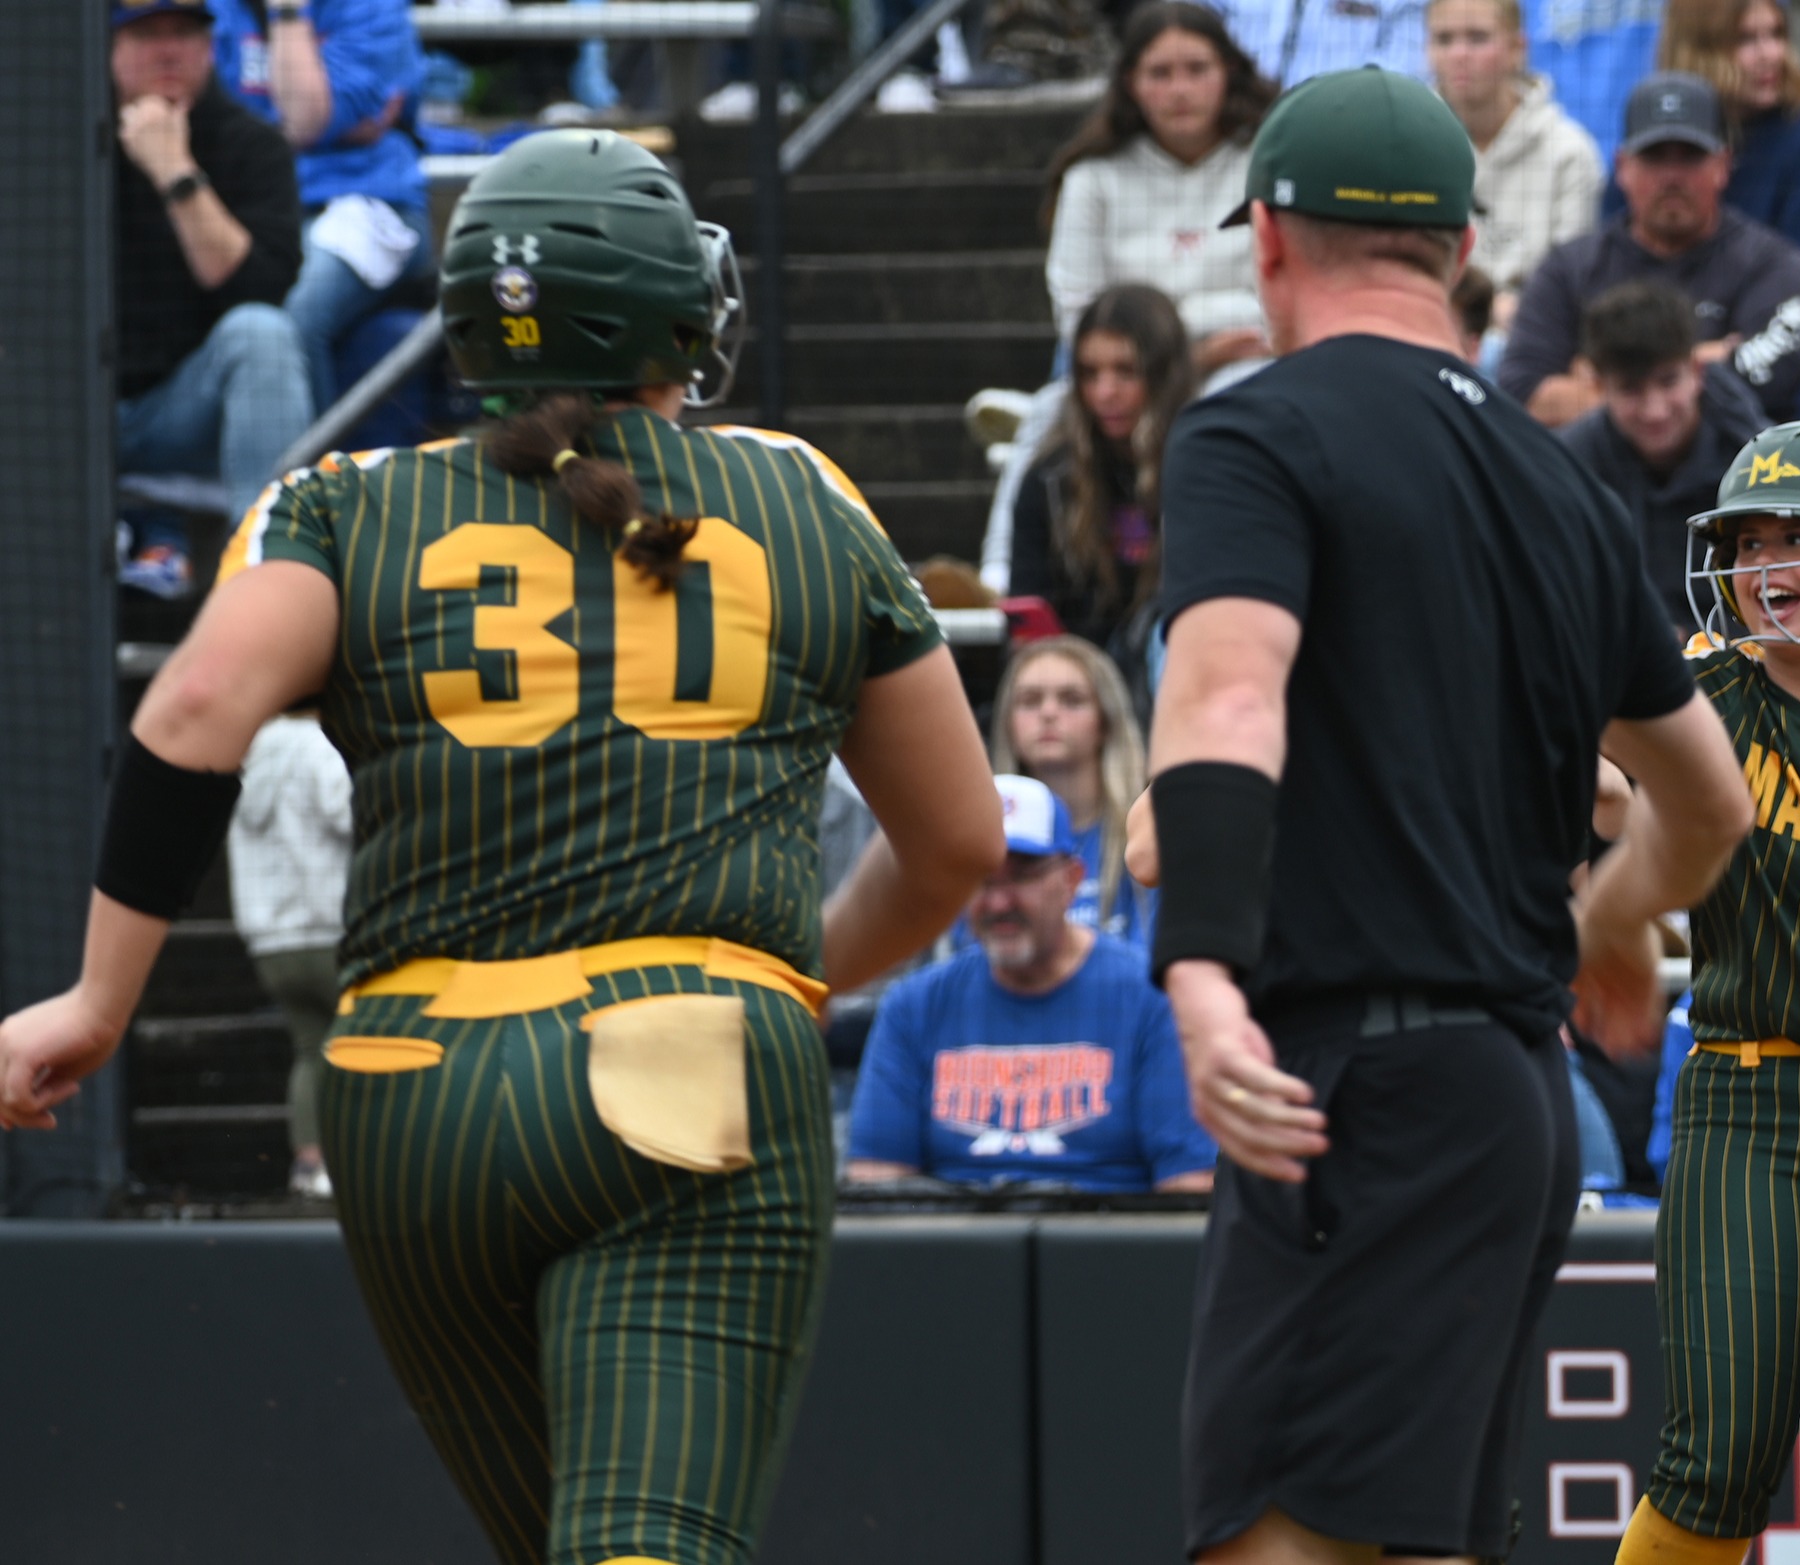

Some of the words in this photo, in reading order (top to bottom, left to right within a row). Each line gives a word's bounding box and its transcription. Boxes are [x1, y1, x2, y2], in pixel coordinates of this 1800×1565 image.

[501, 316, 541, 346] 30
[418, 516, 772, 748] 30
[932, 1083, 1111, 1131] SOFTBALL
